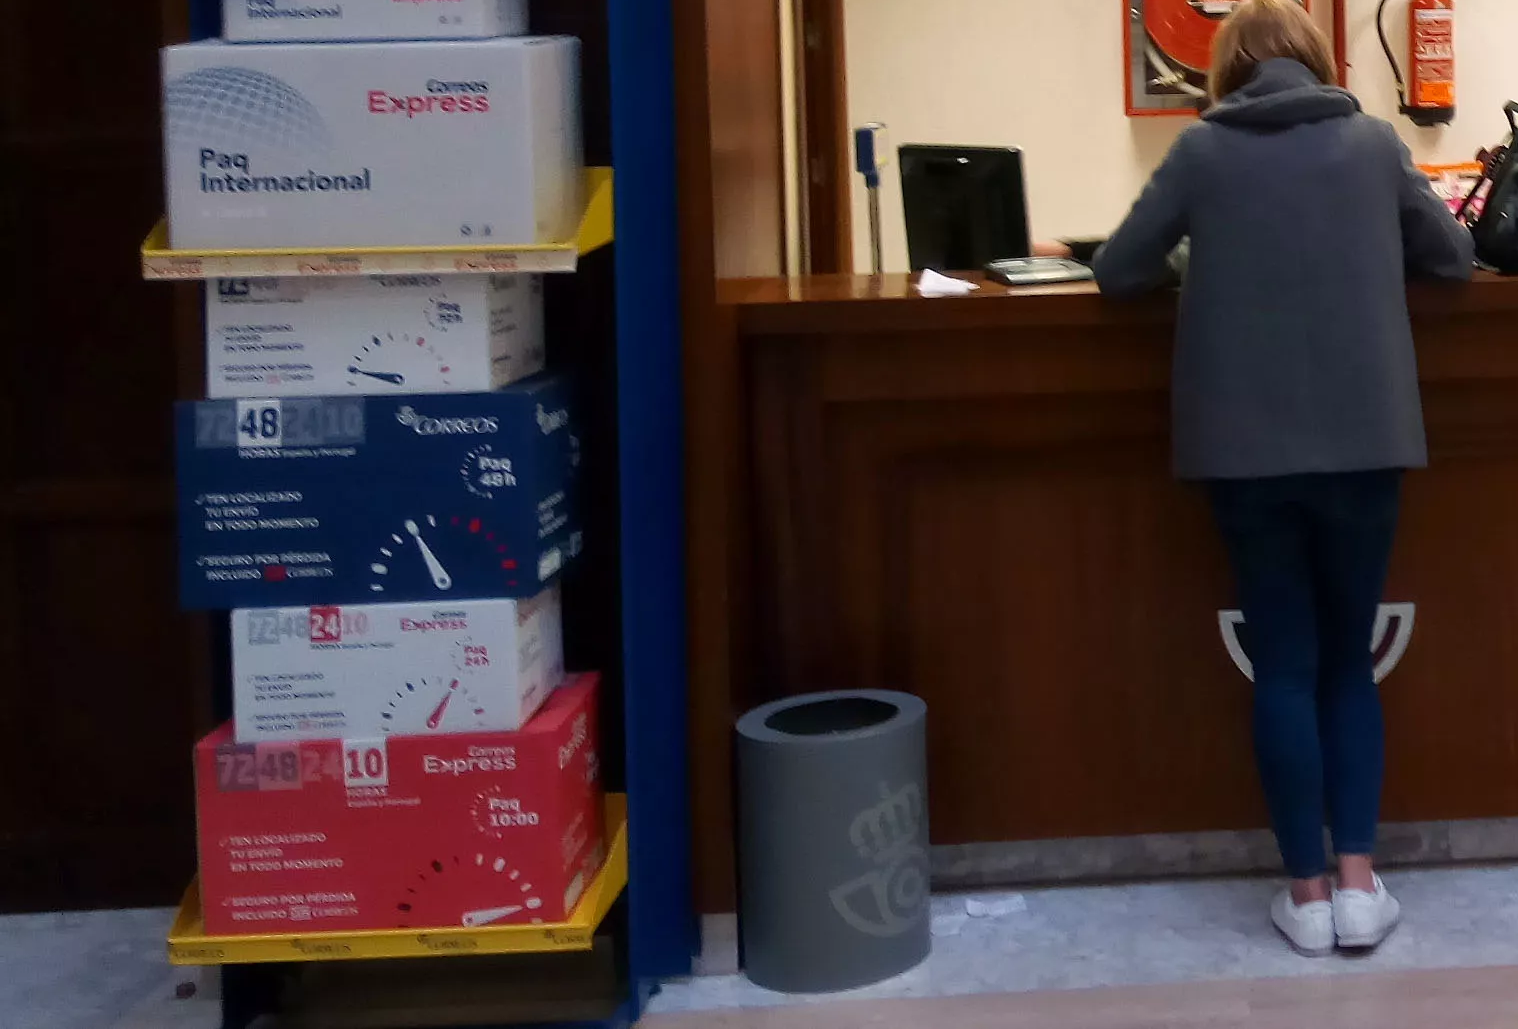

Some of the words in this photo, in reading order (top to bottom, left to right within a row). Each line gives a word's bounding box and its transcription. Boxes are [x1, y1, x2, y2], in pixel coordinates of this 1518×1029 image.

[425, 78, 489, 94] Correos
[367, 90, 491, 118] Express
[200, 148, 250, 174] Paq
[200, 168, 372, 194] Internacional
[239, 406, 278, 439] 48
[414, 417, 499, 436] CORREOS
[311, 613, 340, 639] 24
[400, 618, 468, 633] Express
[468, 745, 516, 757] Correos
[218, 754, 256, 786] 72
[261, 750, 298, 783] 48
[346, 748, 383, 779] 10
[423, 754, 516, 777] Express
[488, 798, 521, 813] Paq
[489, 812, 540, 827] 10:00
[230, 835, 251, 847] TEN
[254, 832, 327, 846] LOCALIZADO
[230, 848, 246, 859] TU
[230, 862, 247, 873] EN
[250, 861, 282, 872] TODO
[283, 858, 344, 871] MOMENTO
[232, 896, 279, 908] SEGURO
[281, 894, 305, 906] POR
[232, 910, 287, 921] INCLUIDO
